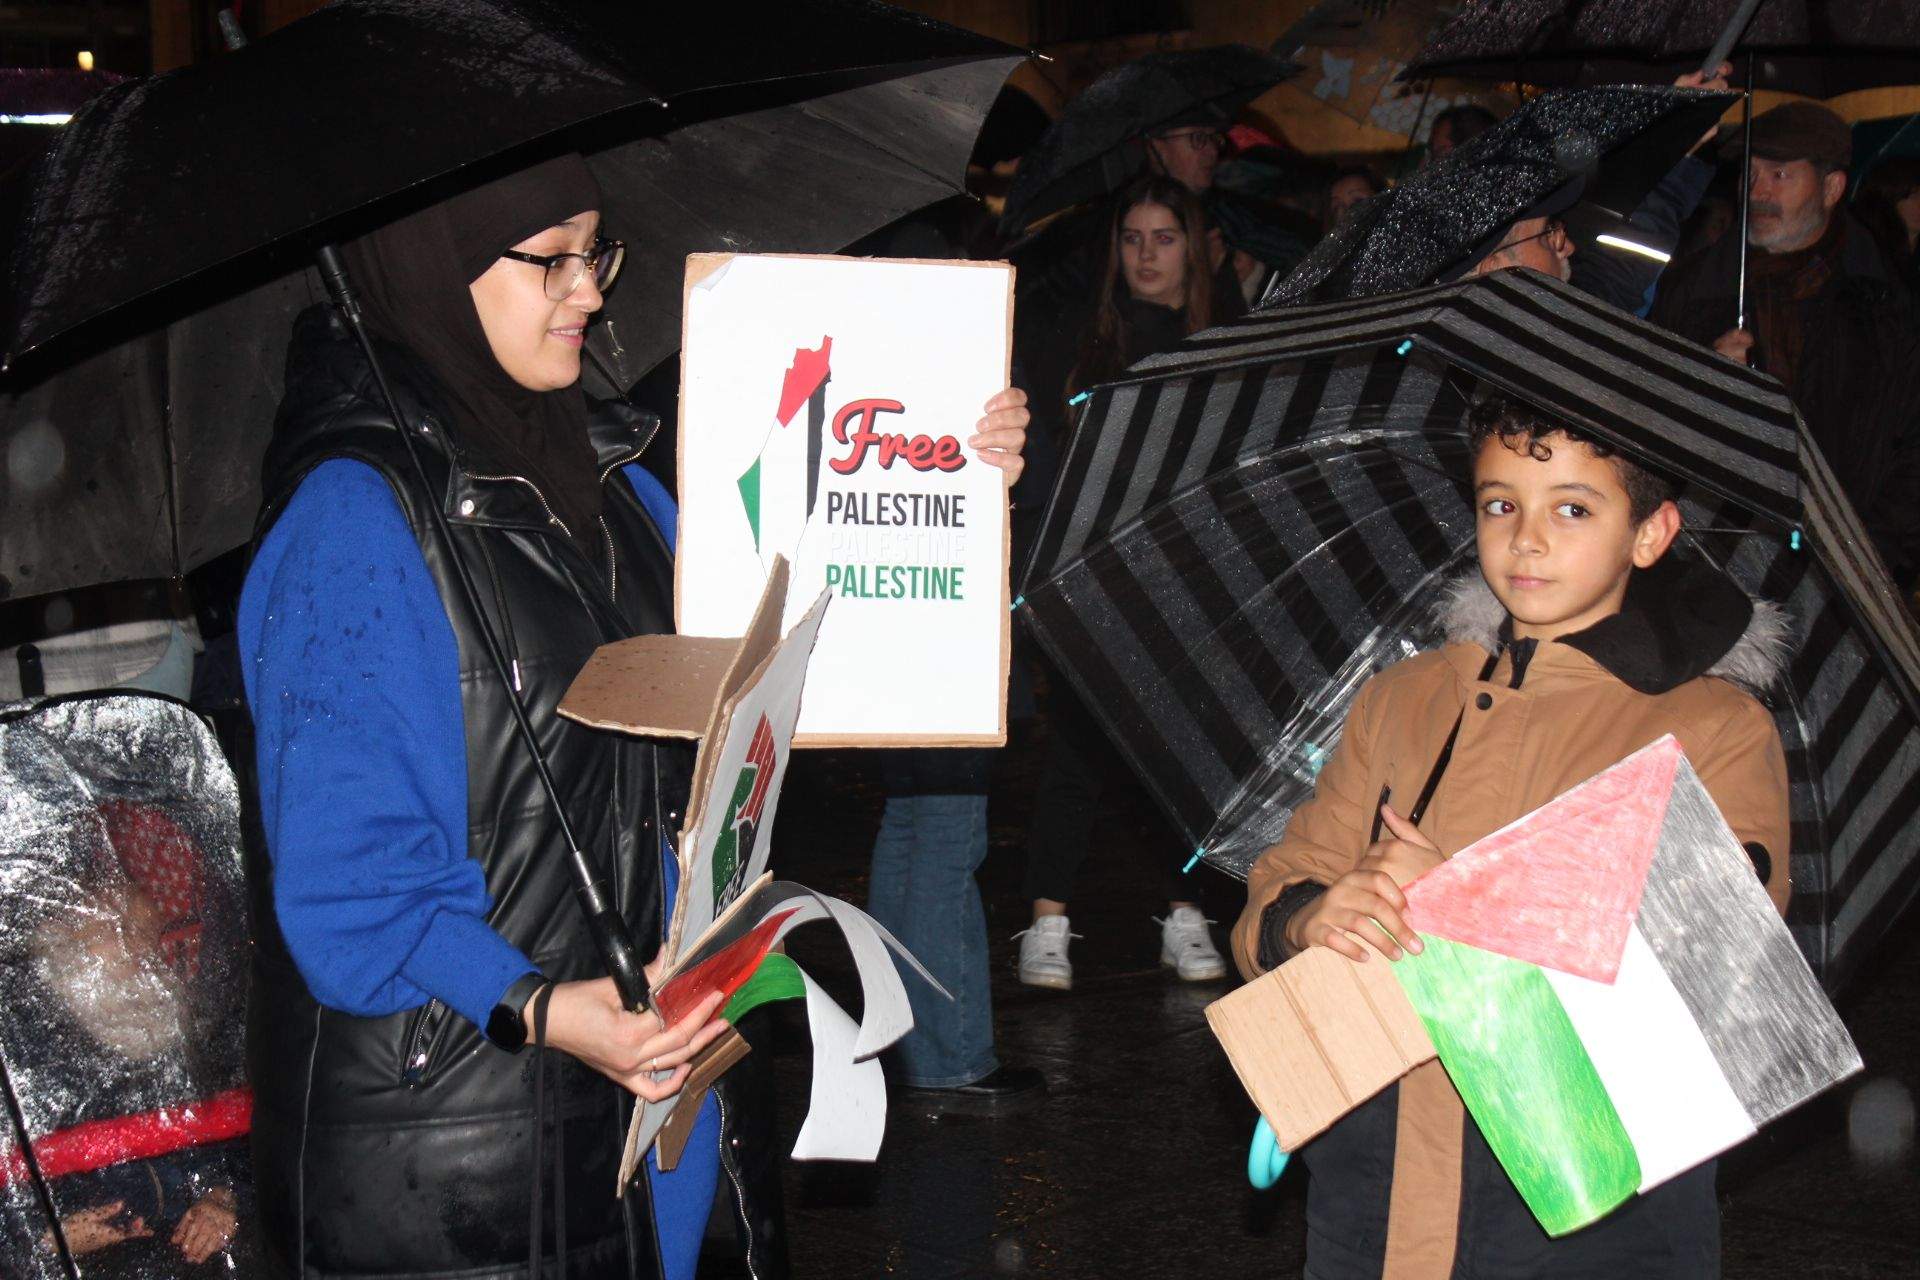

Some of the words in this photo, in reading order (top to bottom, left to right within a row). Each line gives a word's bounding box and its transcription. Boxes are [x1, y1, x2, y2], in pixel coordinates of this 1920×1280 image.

[829, 398, 967, 475] Free
[827, 491, 966, 528] PALESTINE
[829, 529, 967, 565] PALESTINE
[826, 564, 964, 600] PALESTINE
